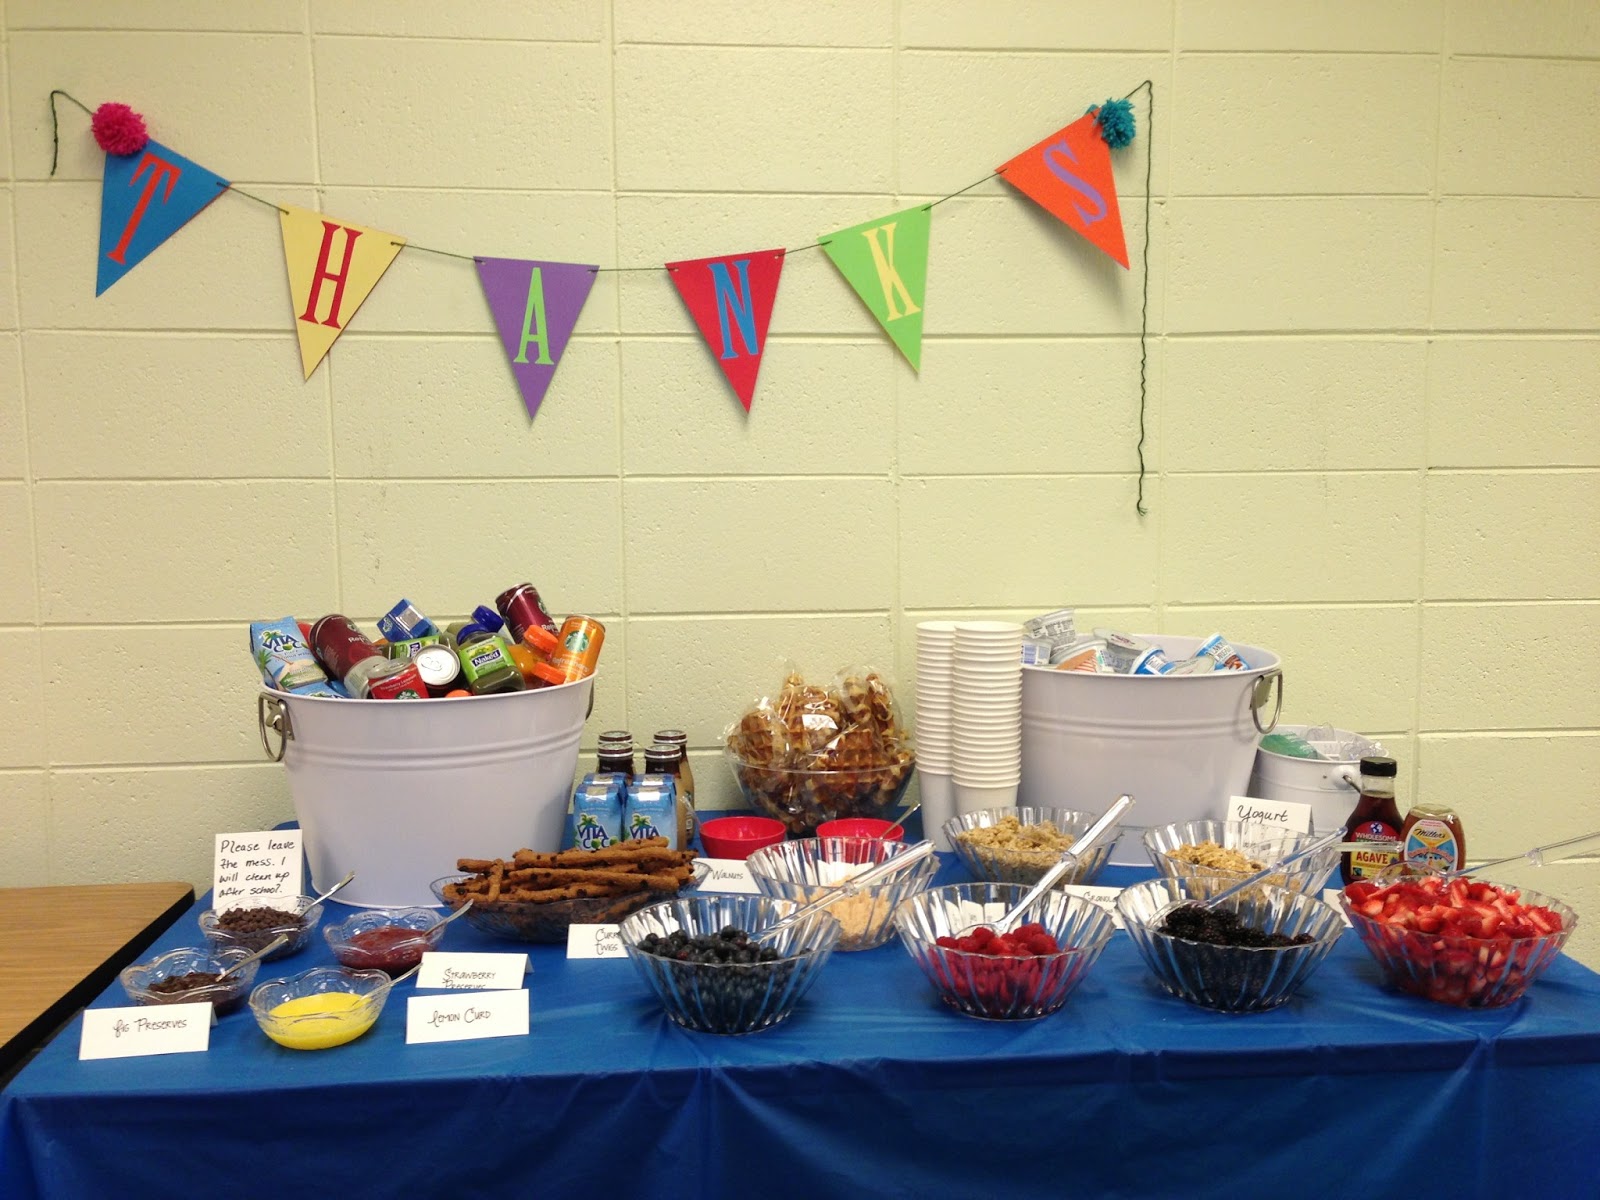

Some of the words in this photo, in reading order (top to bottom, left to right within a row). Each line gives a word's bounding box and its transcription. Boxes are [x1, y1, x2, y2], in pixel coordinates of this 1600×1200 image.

[261, 633, 300, 650] VITA
[473, 651, 500, 666] Naked
[1237, 804, 1289, 825] Yogurt
[576, 825, 610, 841] VITA
[629, 824, 661, 840] VITA
[1355, 832, 1397, 842] WHOLESOME
[220, 839, 260, 854] Please
[267, 839, 295, 851] leave
[219, 858, 239, 870] the
[245, 858, 275, 867] mess.
[1356, 850, 1389, 865] AGAVE
[218, 872, 239, 884] will
[245, 873, 272, 882] clean
[275, 871, 290, 883] up
[711, 868, 744, 881] WALNUTS
[218, 886, 245, 898] after
[443, 967, 497, 980] STRAWBERRY
[463, 1006, 492, 1024] CURD
[133, 1017, 188, 1032] PRESERVES
